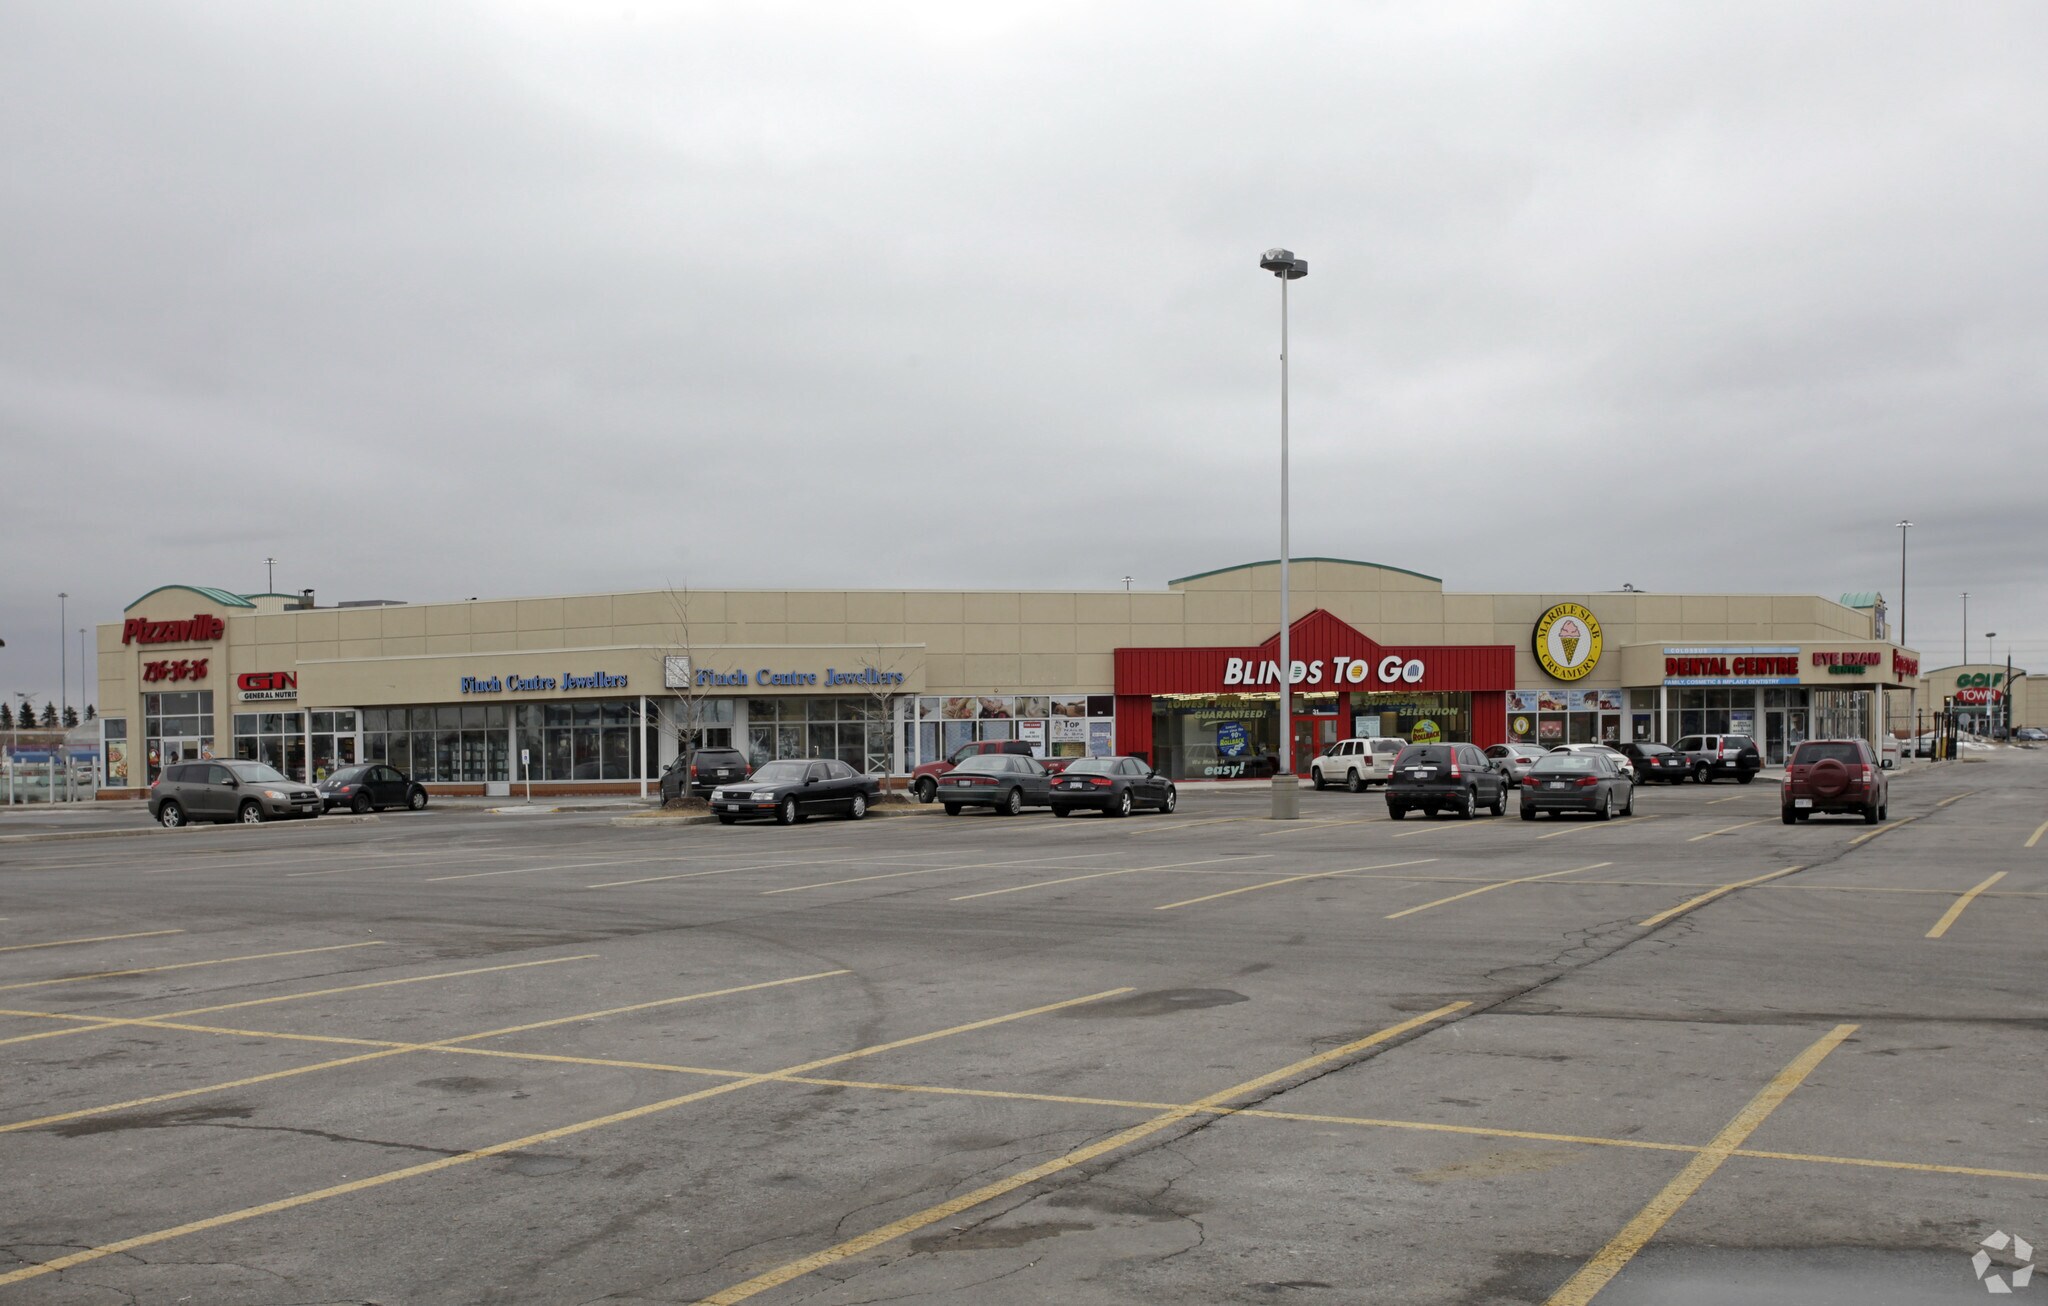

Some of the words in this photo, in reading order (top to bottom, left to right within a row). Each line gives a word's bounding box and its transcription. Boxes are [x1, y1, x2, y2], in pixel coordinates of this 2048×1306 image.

[122, 614, 225, 645] Pizzaville
[1538, 605, 1577, 640] MARBLE
[1579, 608, 1600, 639] SLAB
[1542, 654, 1596, 678] CREAMERY
[1665, 657, 1730, 676] DENTAL
[1733, 657, 1799, 676] CENTRE
[1812, 652, 1840, 666] EYE
[1842, 652, 1881, 666] EXAM
[143, 658, 209, 683] 736-36-36
[696, 669, 748, 687] Finch
[756, 669, 817, 686] Centre
[824, 668, 904, 687] Jewellers
[1224, 657, 1324, 685] BLINDS
[1333, 656, 1369, 684] TO
[1378, 655, 1425, 683] GO
[1828, 665, 1866, 675] CENTRE
[461, 675, 502, 693] Finch
[505, 674, 555, 691] Centre
[560, 671, 628, 691] Jewellers
[1957, 673, 2003, 688] GOLF
[244, 692, 273, 700] GENERAL
[1167, 700, 1212, 708] LOWEST
[1214, 699, 1250, 708] PRICES
[1194, 710, 1266, 719] GUARANTEED!
[1399, 708, 1458, 716] SELECTION
[1064, 720, 1079, 728] TOP
[1220, 738, 1245, 747] ROLLBACK
[1412, 731, 1440, 741] ROLLBACK
[1204, 761, 1246, 778] easy!
